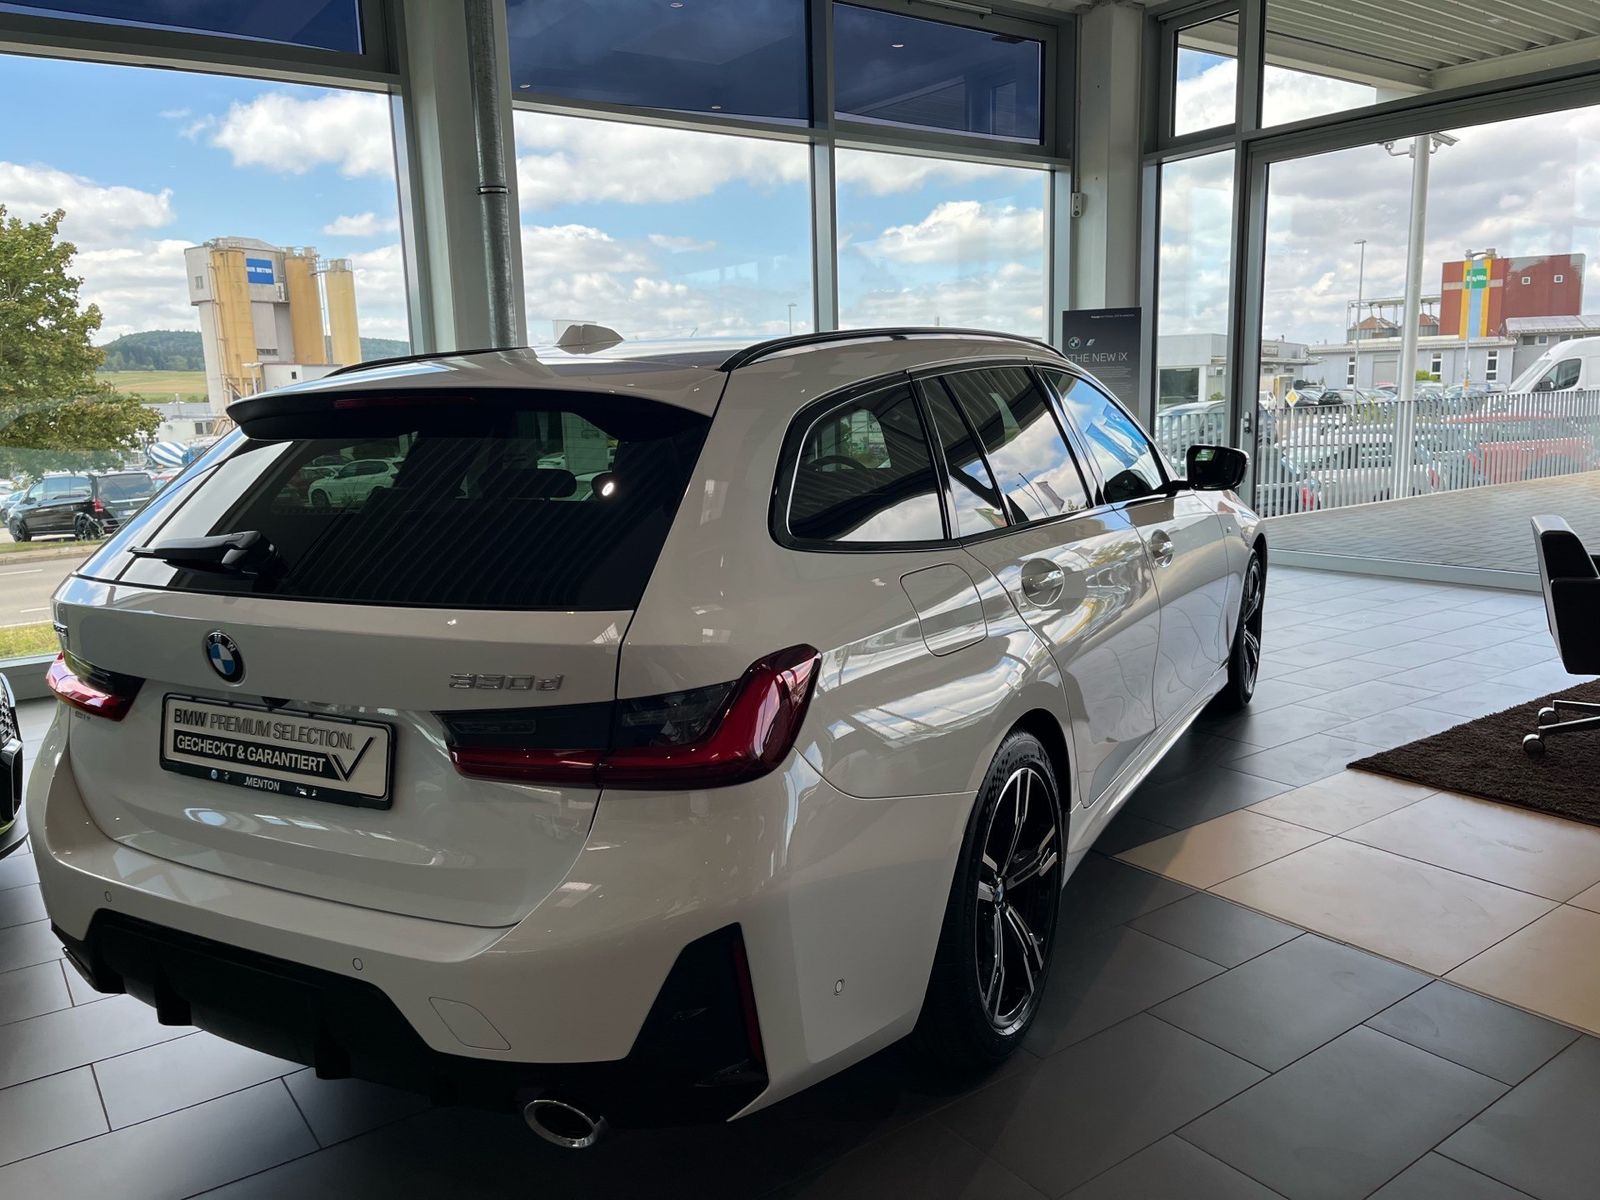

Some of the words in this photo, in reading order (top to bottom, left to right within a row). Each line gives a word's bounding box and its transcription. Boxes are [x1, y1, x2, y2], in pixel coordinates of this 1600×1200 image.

[1068, 353, 1089, 362] THE
[1092, 352, 1117, 362] NEW
[449, 673, 565, 691] 330d
[174, 708, 207, 728] BMW
[210, 713, 272, 738] PREMIUM
[177, 735, 236, 757] GECHECKT
[237, 745, 246, 759] &
[247, 747, 326, 773] GARANTIERT
